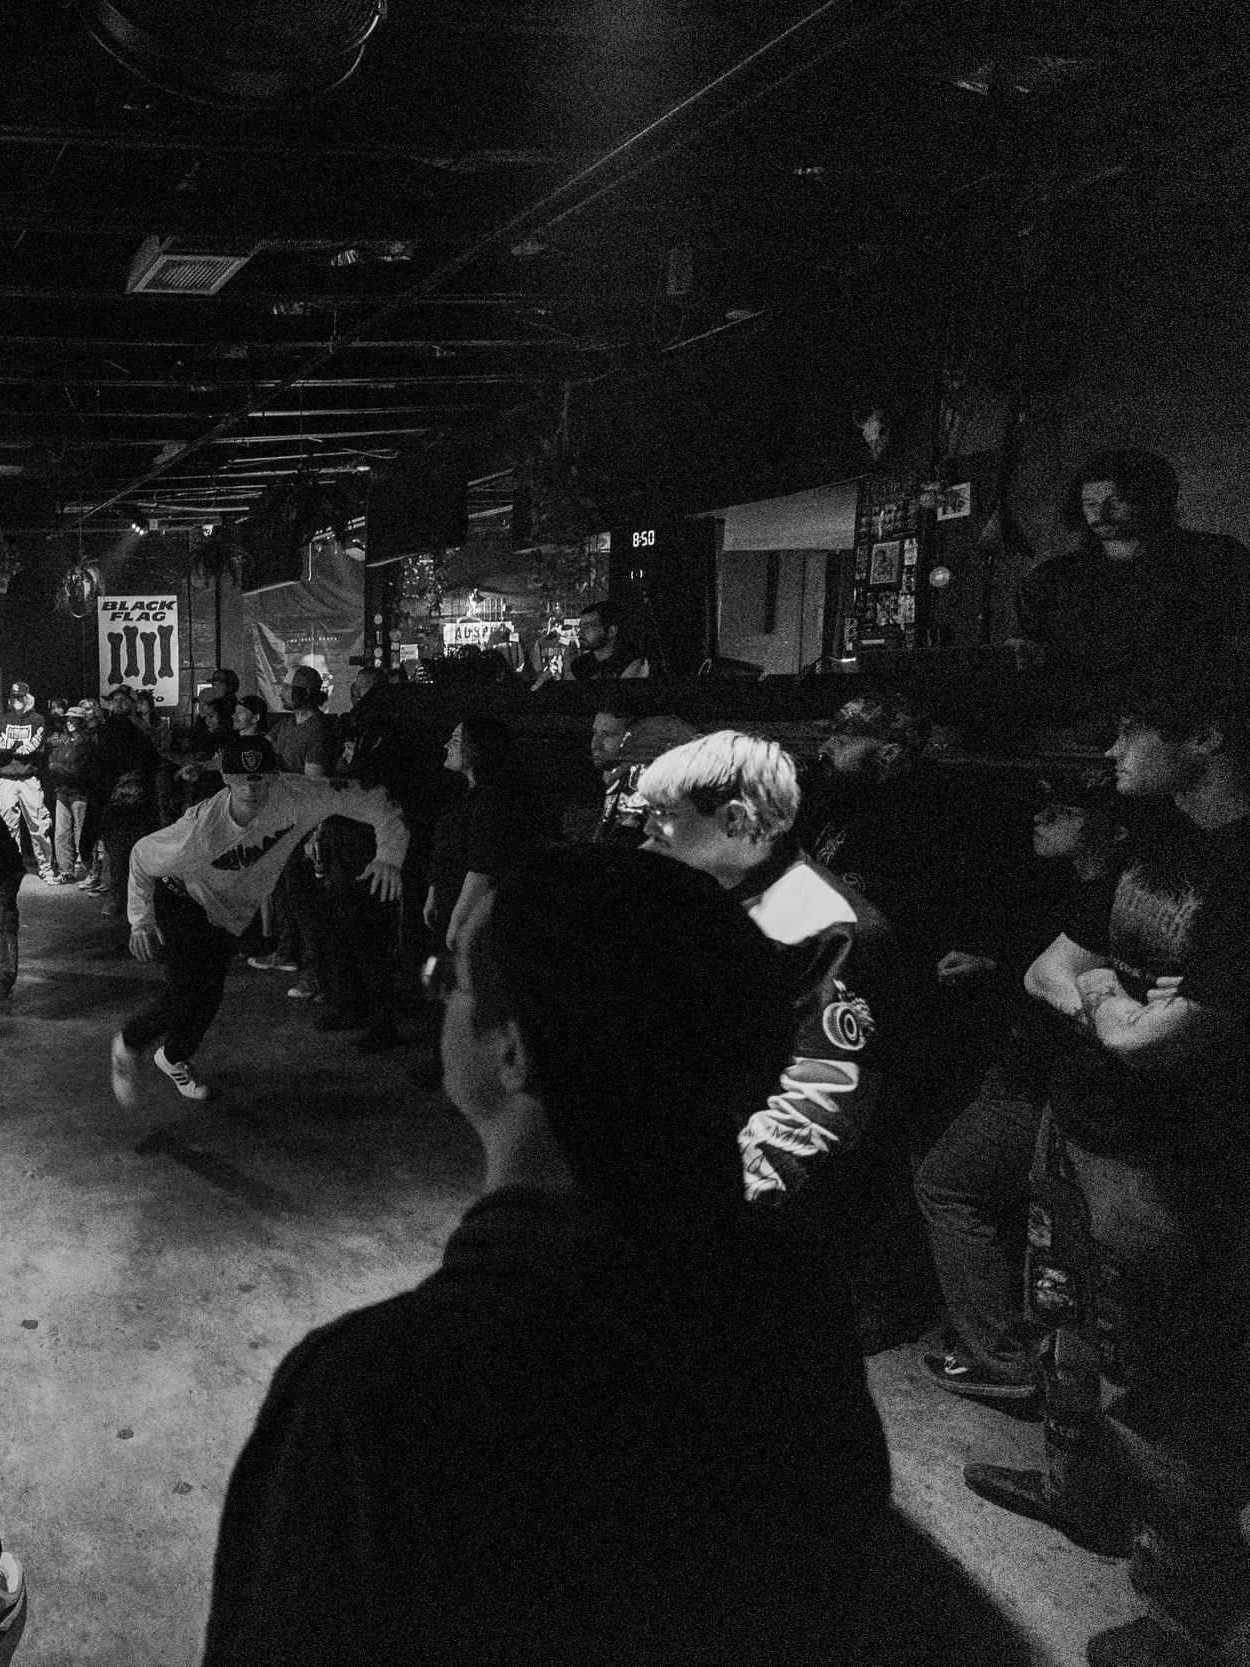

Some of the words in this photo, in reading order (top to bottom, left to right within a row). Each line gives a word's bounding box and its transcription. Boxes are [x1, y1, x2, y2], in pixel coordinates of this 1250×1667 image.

[632, 529, 655, 548] 8:50
[101, 600, 177, 611] BLACK
[110, 611, 166, 622] FLAG
